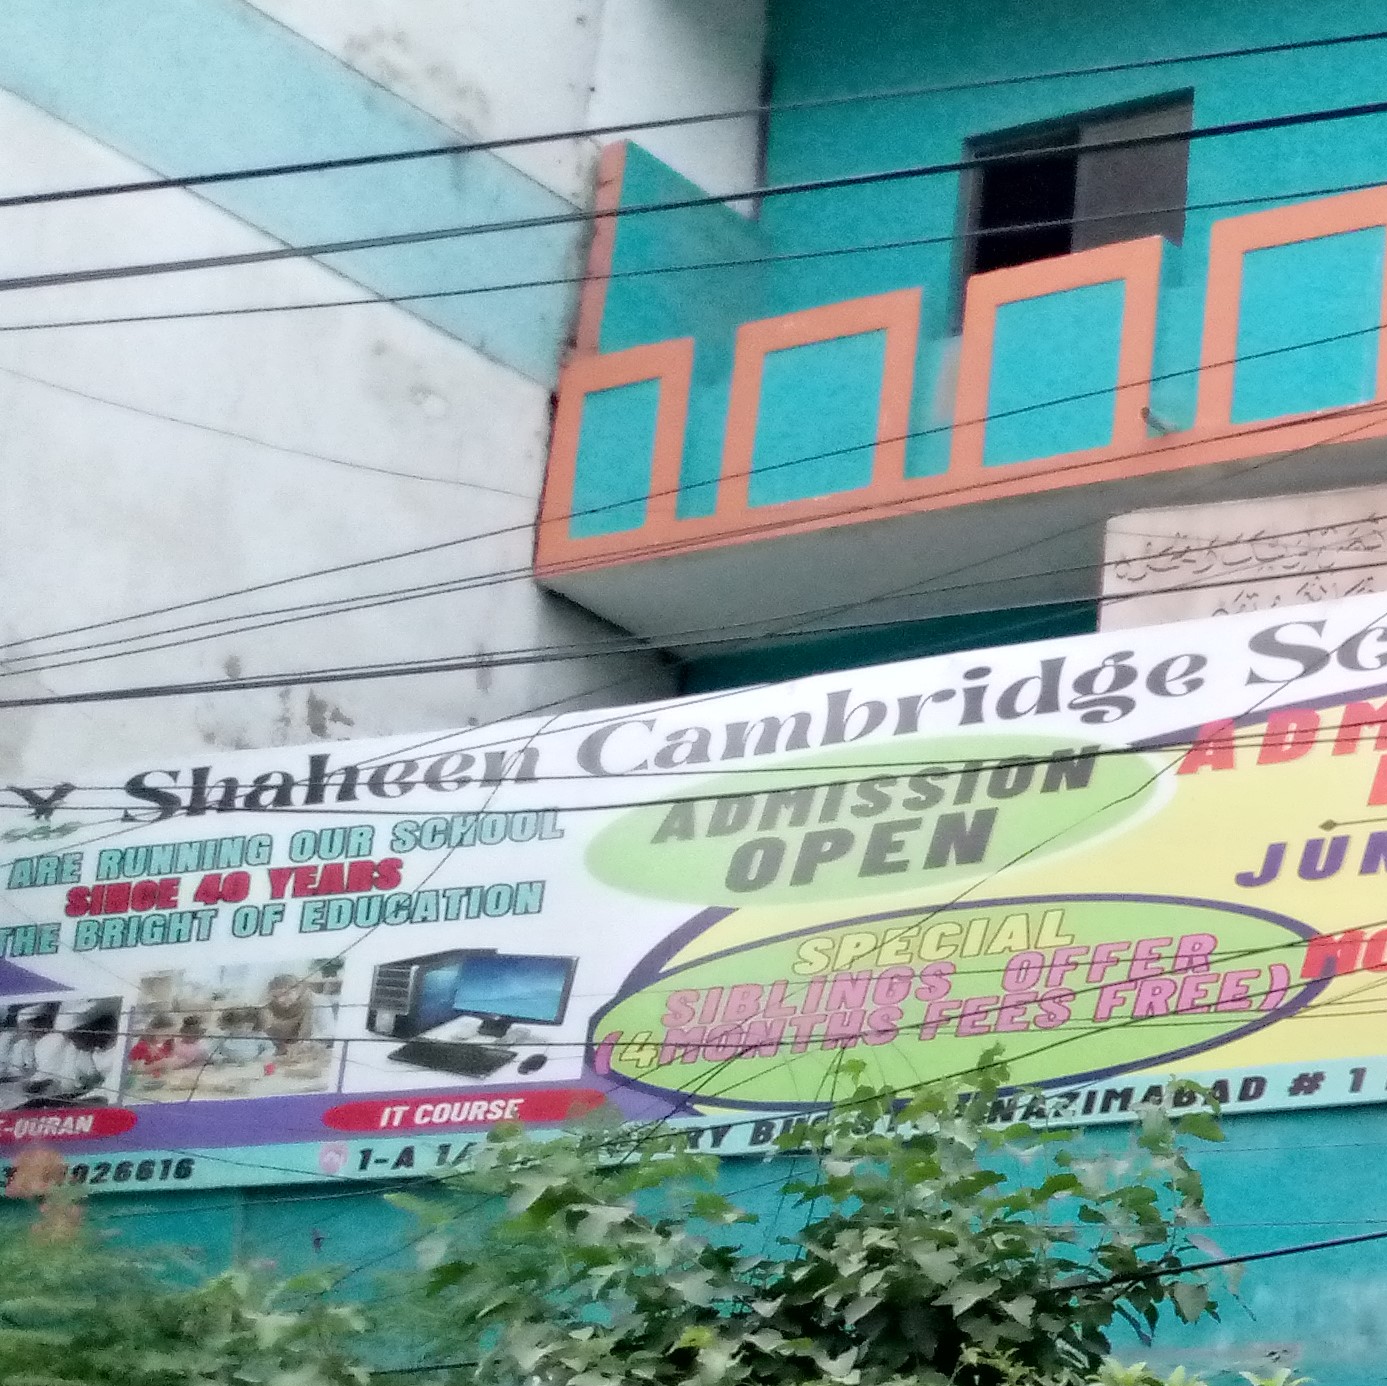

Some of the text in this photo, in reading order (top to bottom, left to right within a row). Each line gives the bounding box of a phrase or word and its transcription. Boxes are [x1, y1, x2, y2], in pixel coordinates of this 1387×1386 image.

[121, 740, 542, 822] Shaheen
[577, 649, 1209, 777] Cambridge
[651, 746, 1102, 845] ADMISSION
[7, 807, 564, 890] ARE RUNNING OUR SCHOOL
[65, 857, 404, 917] SINCE 40 YEARS
[725, 807, 1000, 893] OPEN
[0, 881, 548, 957] THE BRIGHT OF EDUCATION
[793, 909, 1075, 976] SPECIAL
[661, 933, 1219, 1028] SIBLINGS OFFER
[918, 990, 1075, 1040] FEES
[1092, 963, 1291, 1020] FREE)
[358, 1145, 415, 1171] 1-A
[1348, 1067, 1367, 1093] 1
[379, 1099, 524, 1129] IT COURSE
